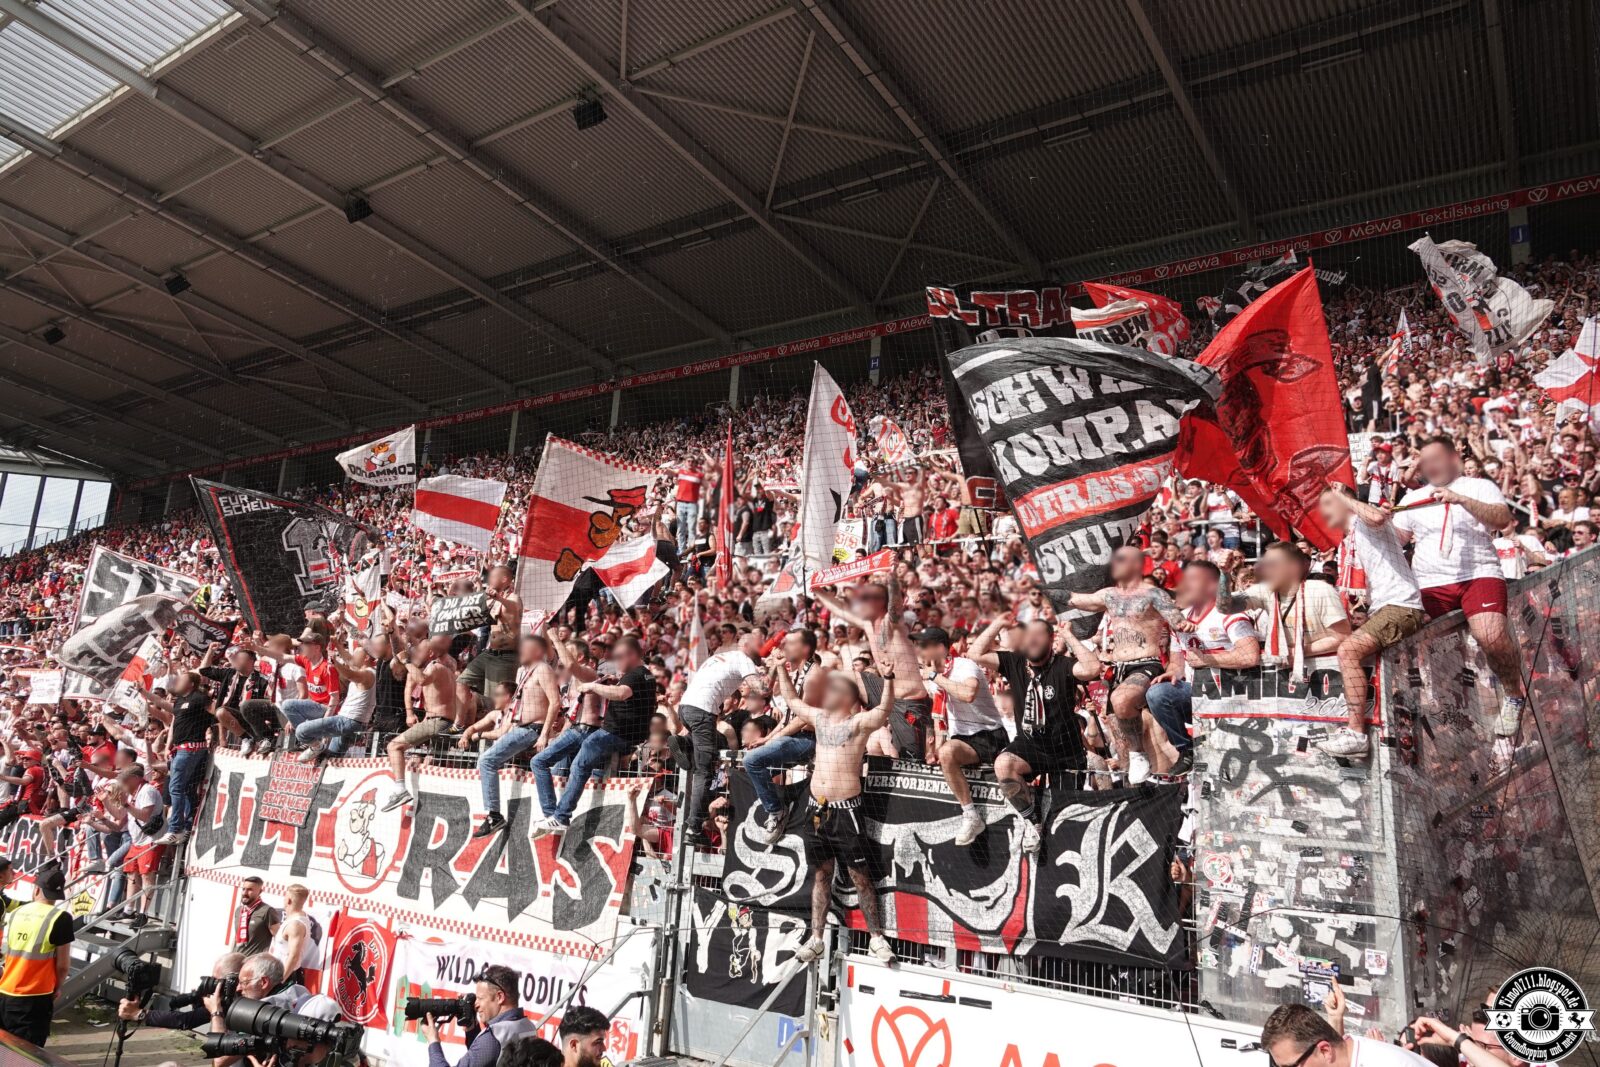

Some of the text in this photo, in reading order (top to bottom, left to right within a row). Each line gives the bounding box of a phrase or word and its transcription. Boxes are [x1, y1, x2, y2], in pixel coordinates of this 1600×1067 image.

[1233, 238, 1309, 262] Textilsharing
[1418, 199, 1509, 224] Textilsharing
[1557, 178, 1600, 197] mew
[638, 370, 676, 383] Textilsharing
[727, 351, 770, 365] Textilsharing
[828, 328, 877, 344] Textilsharing
[871, 359, 878, 367] H
[443, 598, 458, 610] DU
[434, 621, 449, 632] BEI
[195, 764, 626, 931] ULTRAS
[17, 932, 28, 941] 70
[436, 954, 475, 985] WILD
